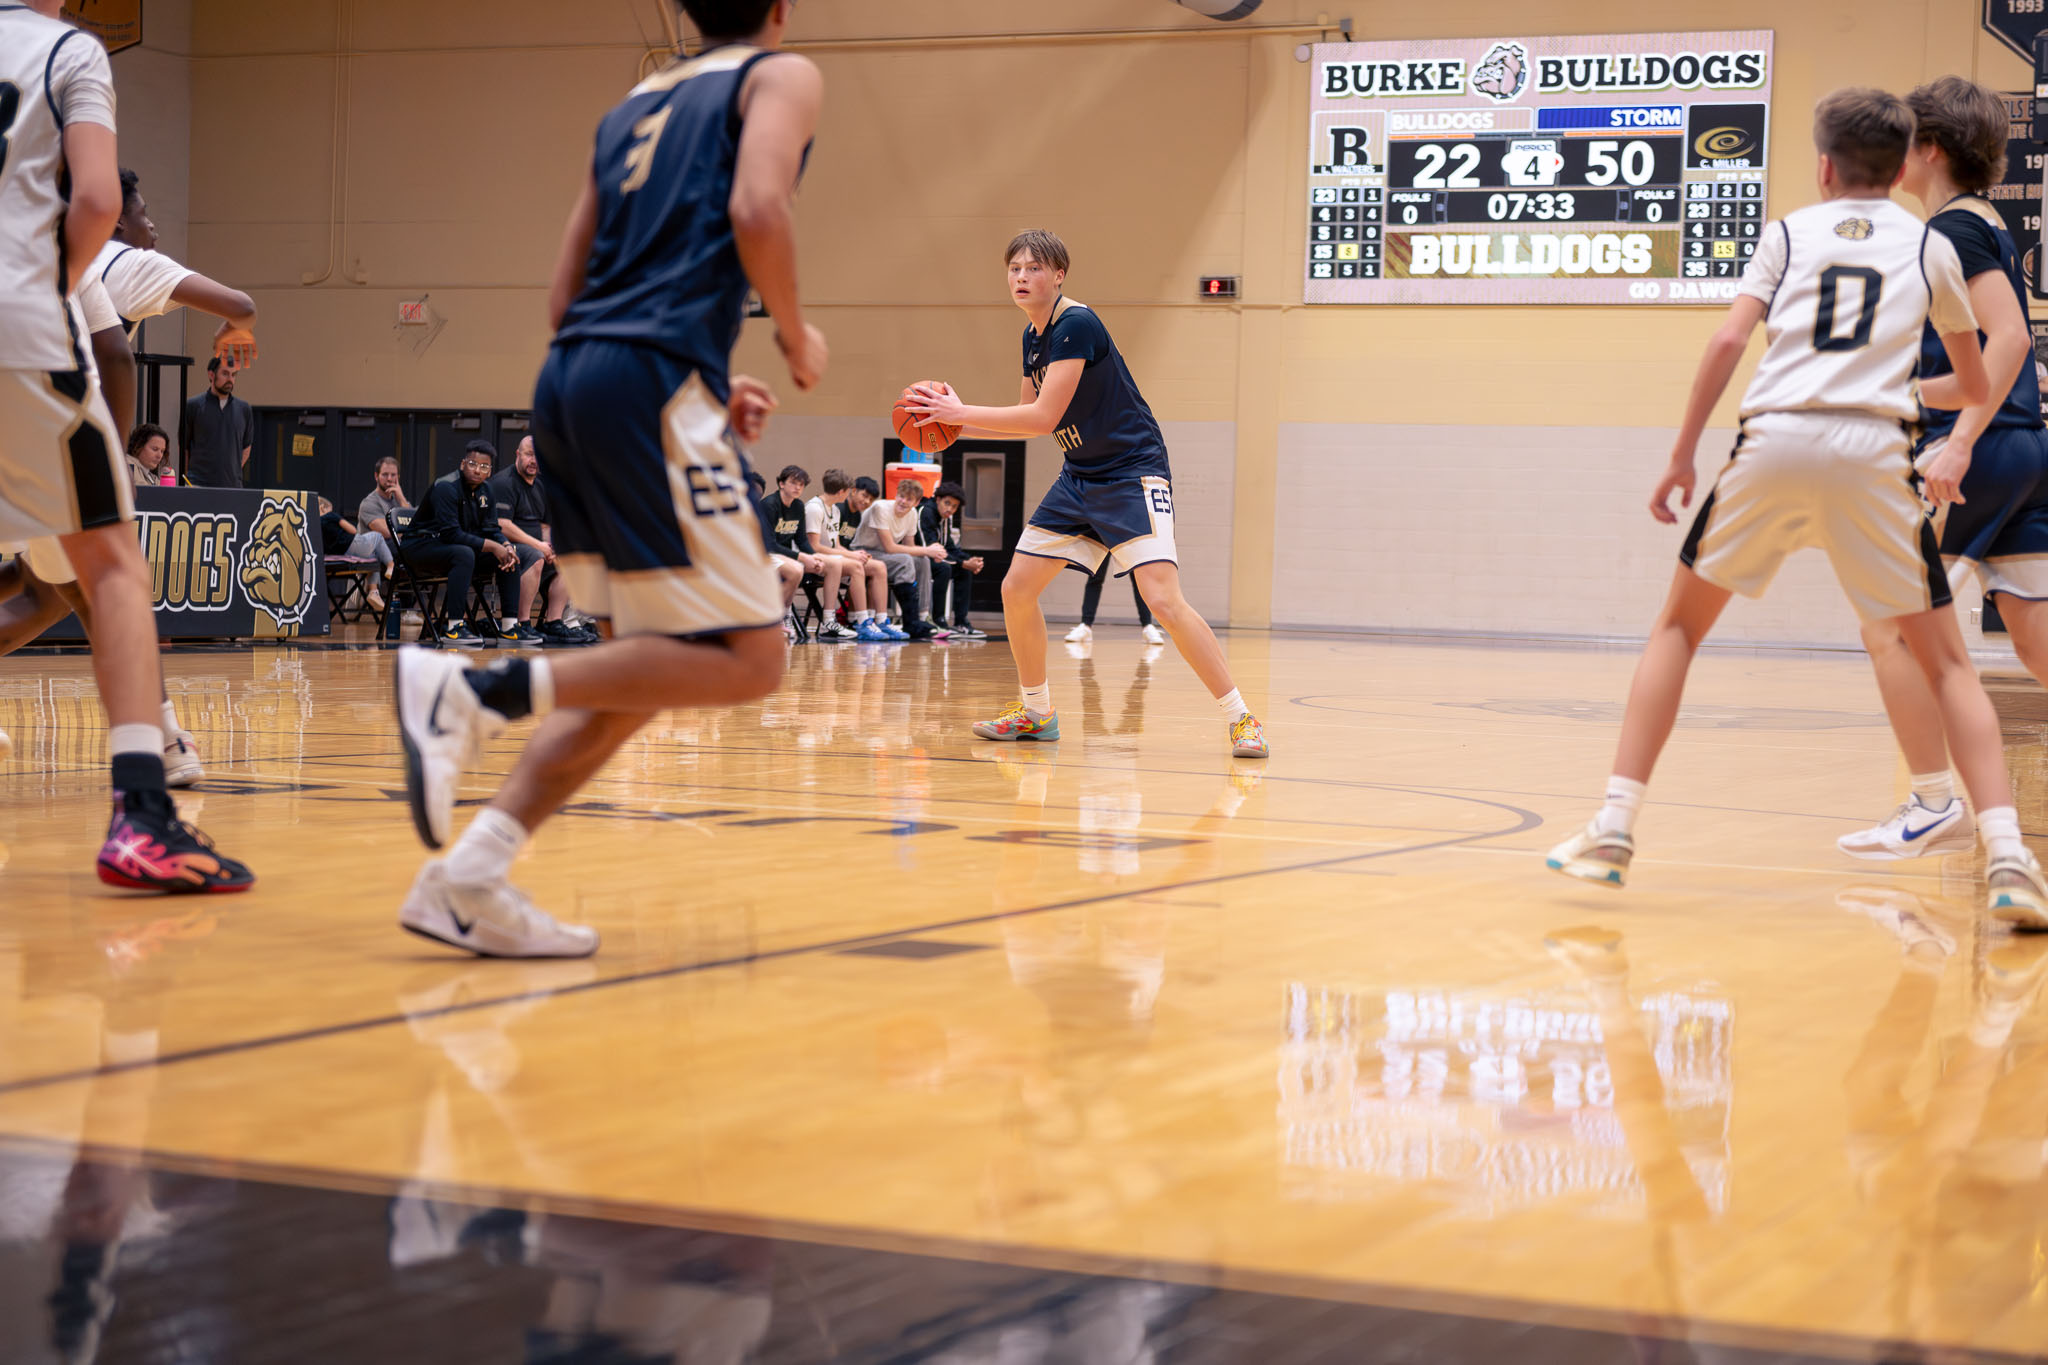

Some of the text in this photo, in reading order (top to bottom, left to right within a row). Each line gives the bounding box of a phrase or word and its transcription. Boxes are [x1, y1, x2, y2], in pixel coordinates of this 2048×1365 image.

[2008, 0, 2044, 13] 1993
[1325, 54, 1762, 93] BURKE BULLDOGS
[1391, 111, 1494, 130] BULLDOGS
[1610, 108, 1681, 127] STORM
[1330, 127, 1368, 166] B
[1413, 143, 1481, 188] 22
[1523, 155, 1541, 181] 4
[1585, 140, 1655, 187] 50
[1712, 158, 1750, 168] MILLER
[1314, 188, 1378, 203] 23 4 1
[1391, 192, 1432, 203] FOULS
[1633, 190, 1676, 200] FOULS
[1690, 184, 1757, 199] 10 2 0
[1987, 184, 2025, 200] STATE
[1318, 207, 1378, 221] 4 3 4
[1402, 204, 1419, 225] 0
[1487, 192, 1575, 221] 07:33
[1646, 202, 1663, 223] 0
[1687, 203, 1756, 219] 23 2 3
[1317, 225, 1331, 240] 5
[1343, 226, 1355, 239] 2
[1691, 222, 1756, 238] 4 1 0
[1313, 244, 1333, 259] 15
[1365, 245, 1376, 258] 1
[1409, 233, 1653, 275] BULLDOGS
[1691, 242, 1705, 258] 3
[1717, 244, 1733, 254] 15
[1313, 263, 1376, 278] 12 5 1
[1685, 261, 1708, 277] 35
[1718, 262, 1730, 275] 7
[1629, 281, 1661, 300] GO
[1811, 263, 1885, 353] 0
[1151, 488, 1171, 514] ES
